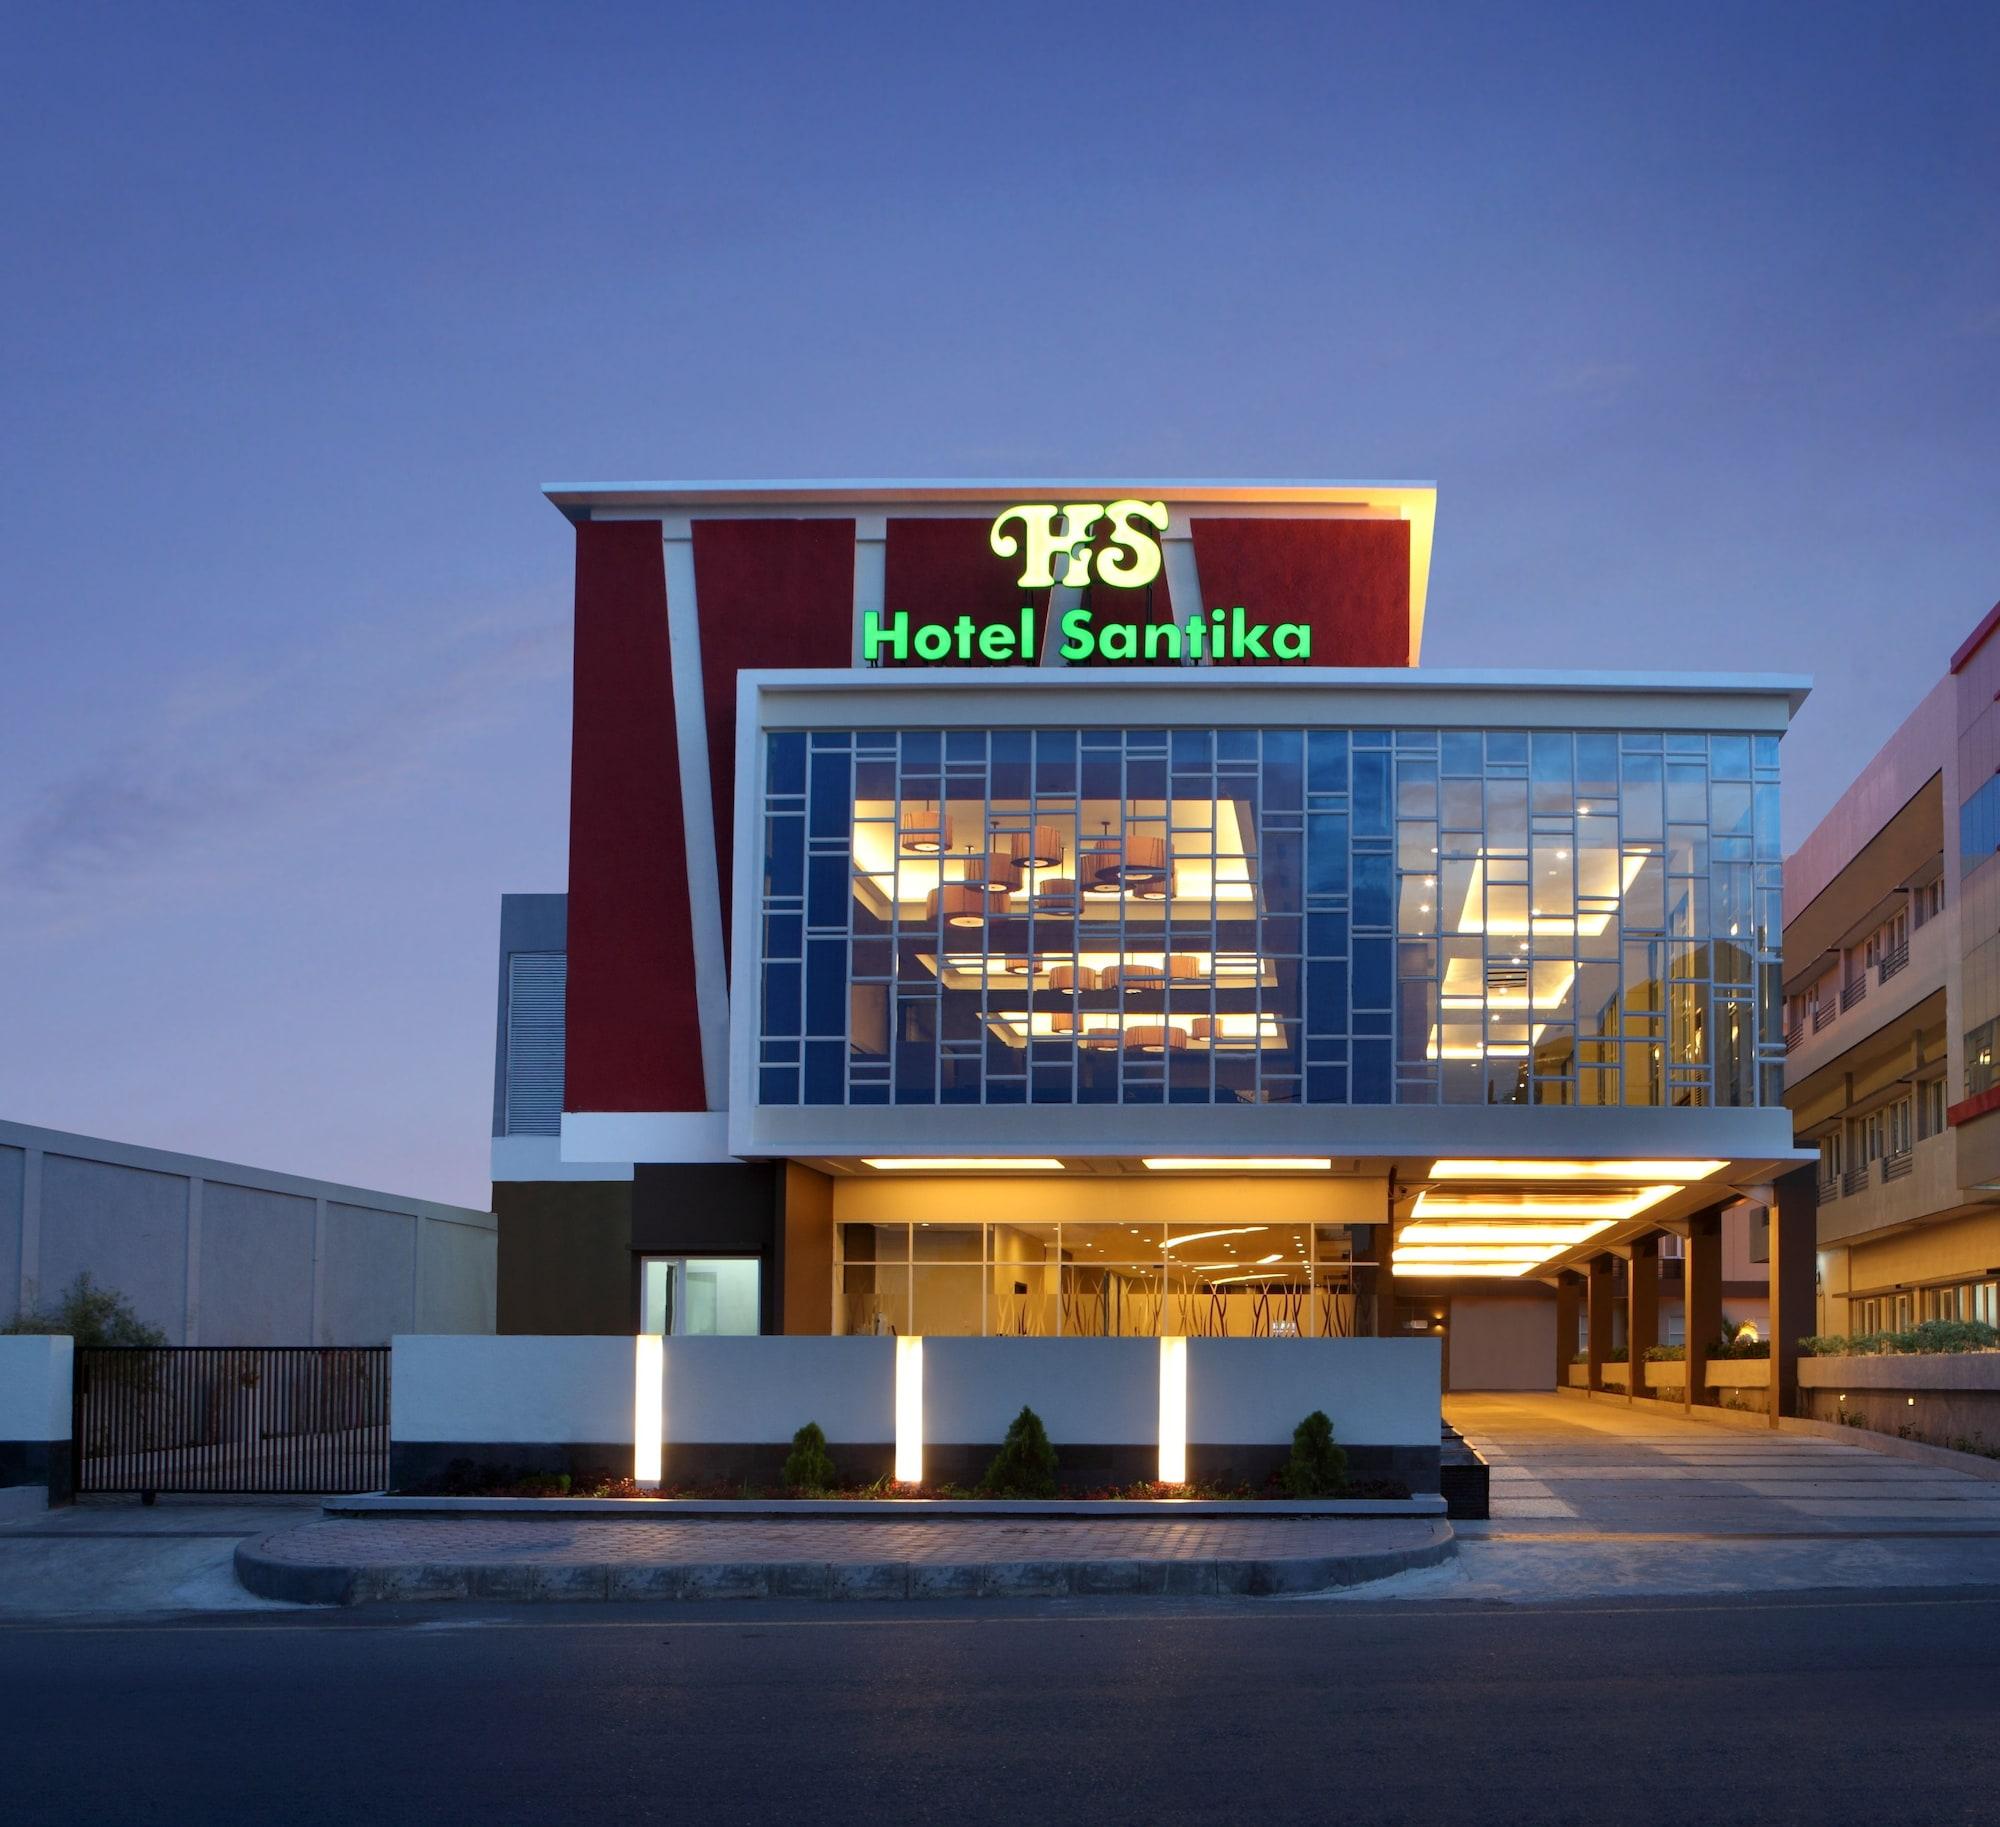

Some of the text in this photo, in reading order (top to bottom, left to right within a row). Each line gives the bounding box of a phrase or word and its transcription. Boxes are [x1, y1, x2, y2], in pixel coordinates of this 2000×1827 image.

[990, 500, 1169, 588] HS
[863, 607, 1312, 661] Hotel Santika
